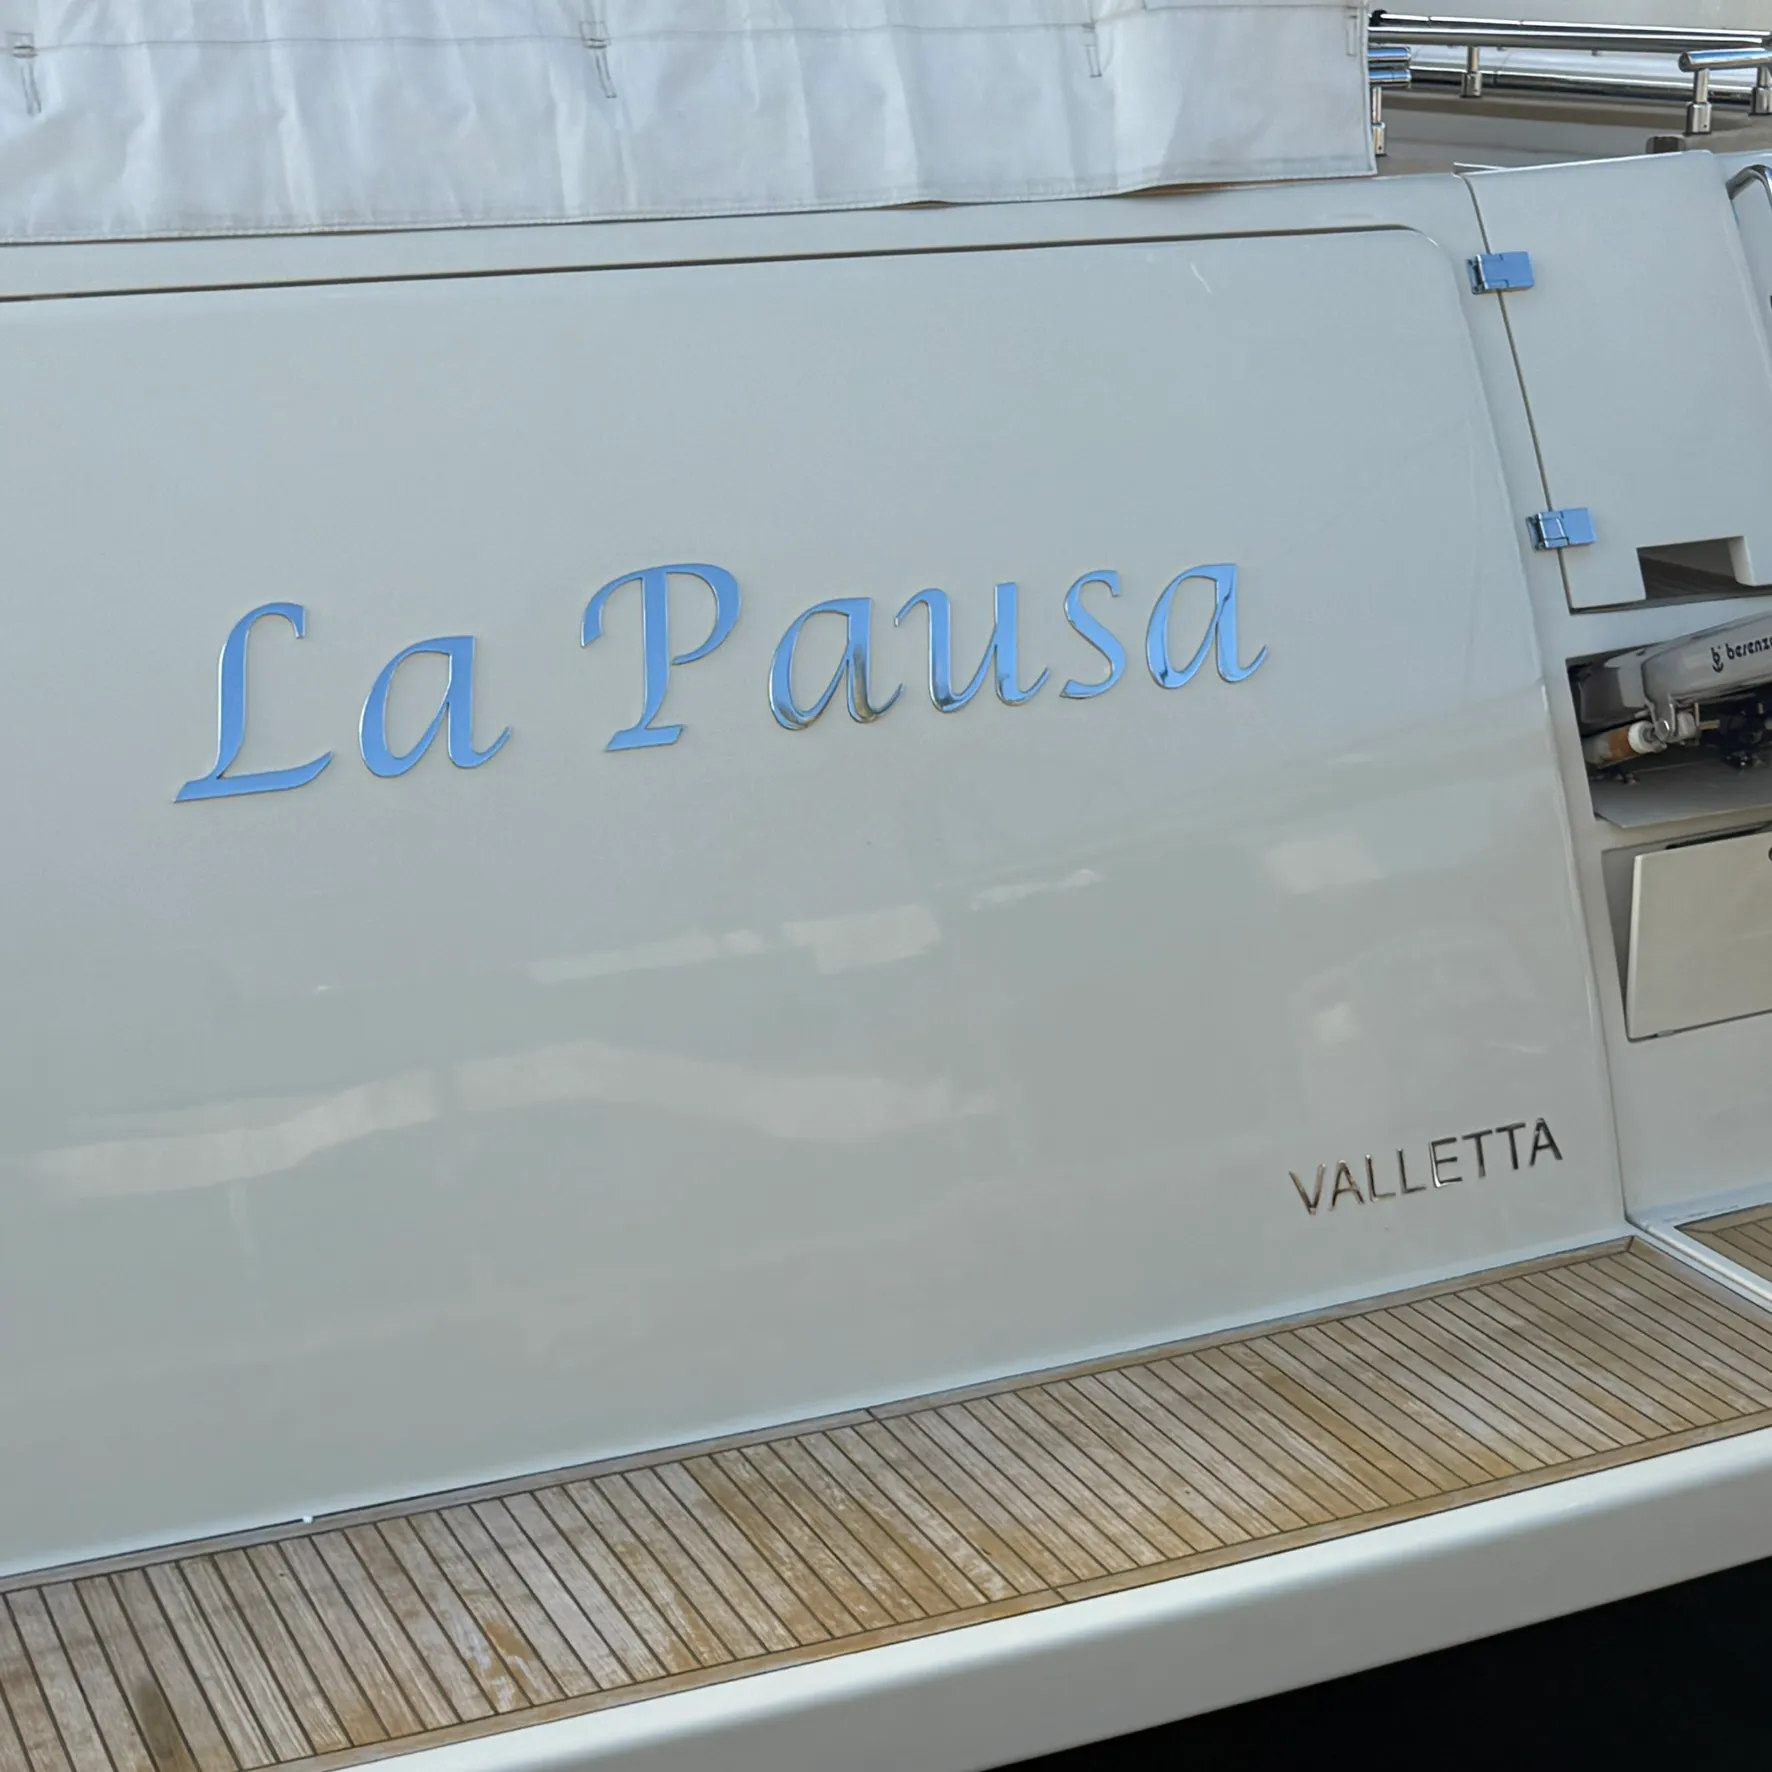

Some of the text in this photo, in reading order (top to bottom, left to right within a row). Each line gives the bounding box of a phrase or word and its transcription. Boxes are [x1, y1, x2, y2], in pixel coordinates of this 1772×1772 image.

[175, 563, 1268, 803] La Pausa
[1289, 1117, 1563, 1215] VALLETTA
